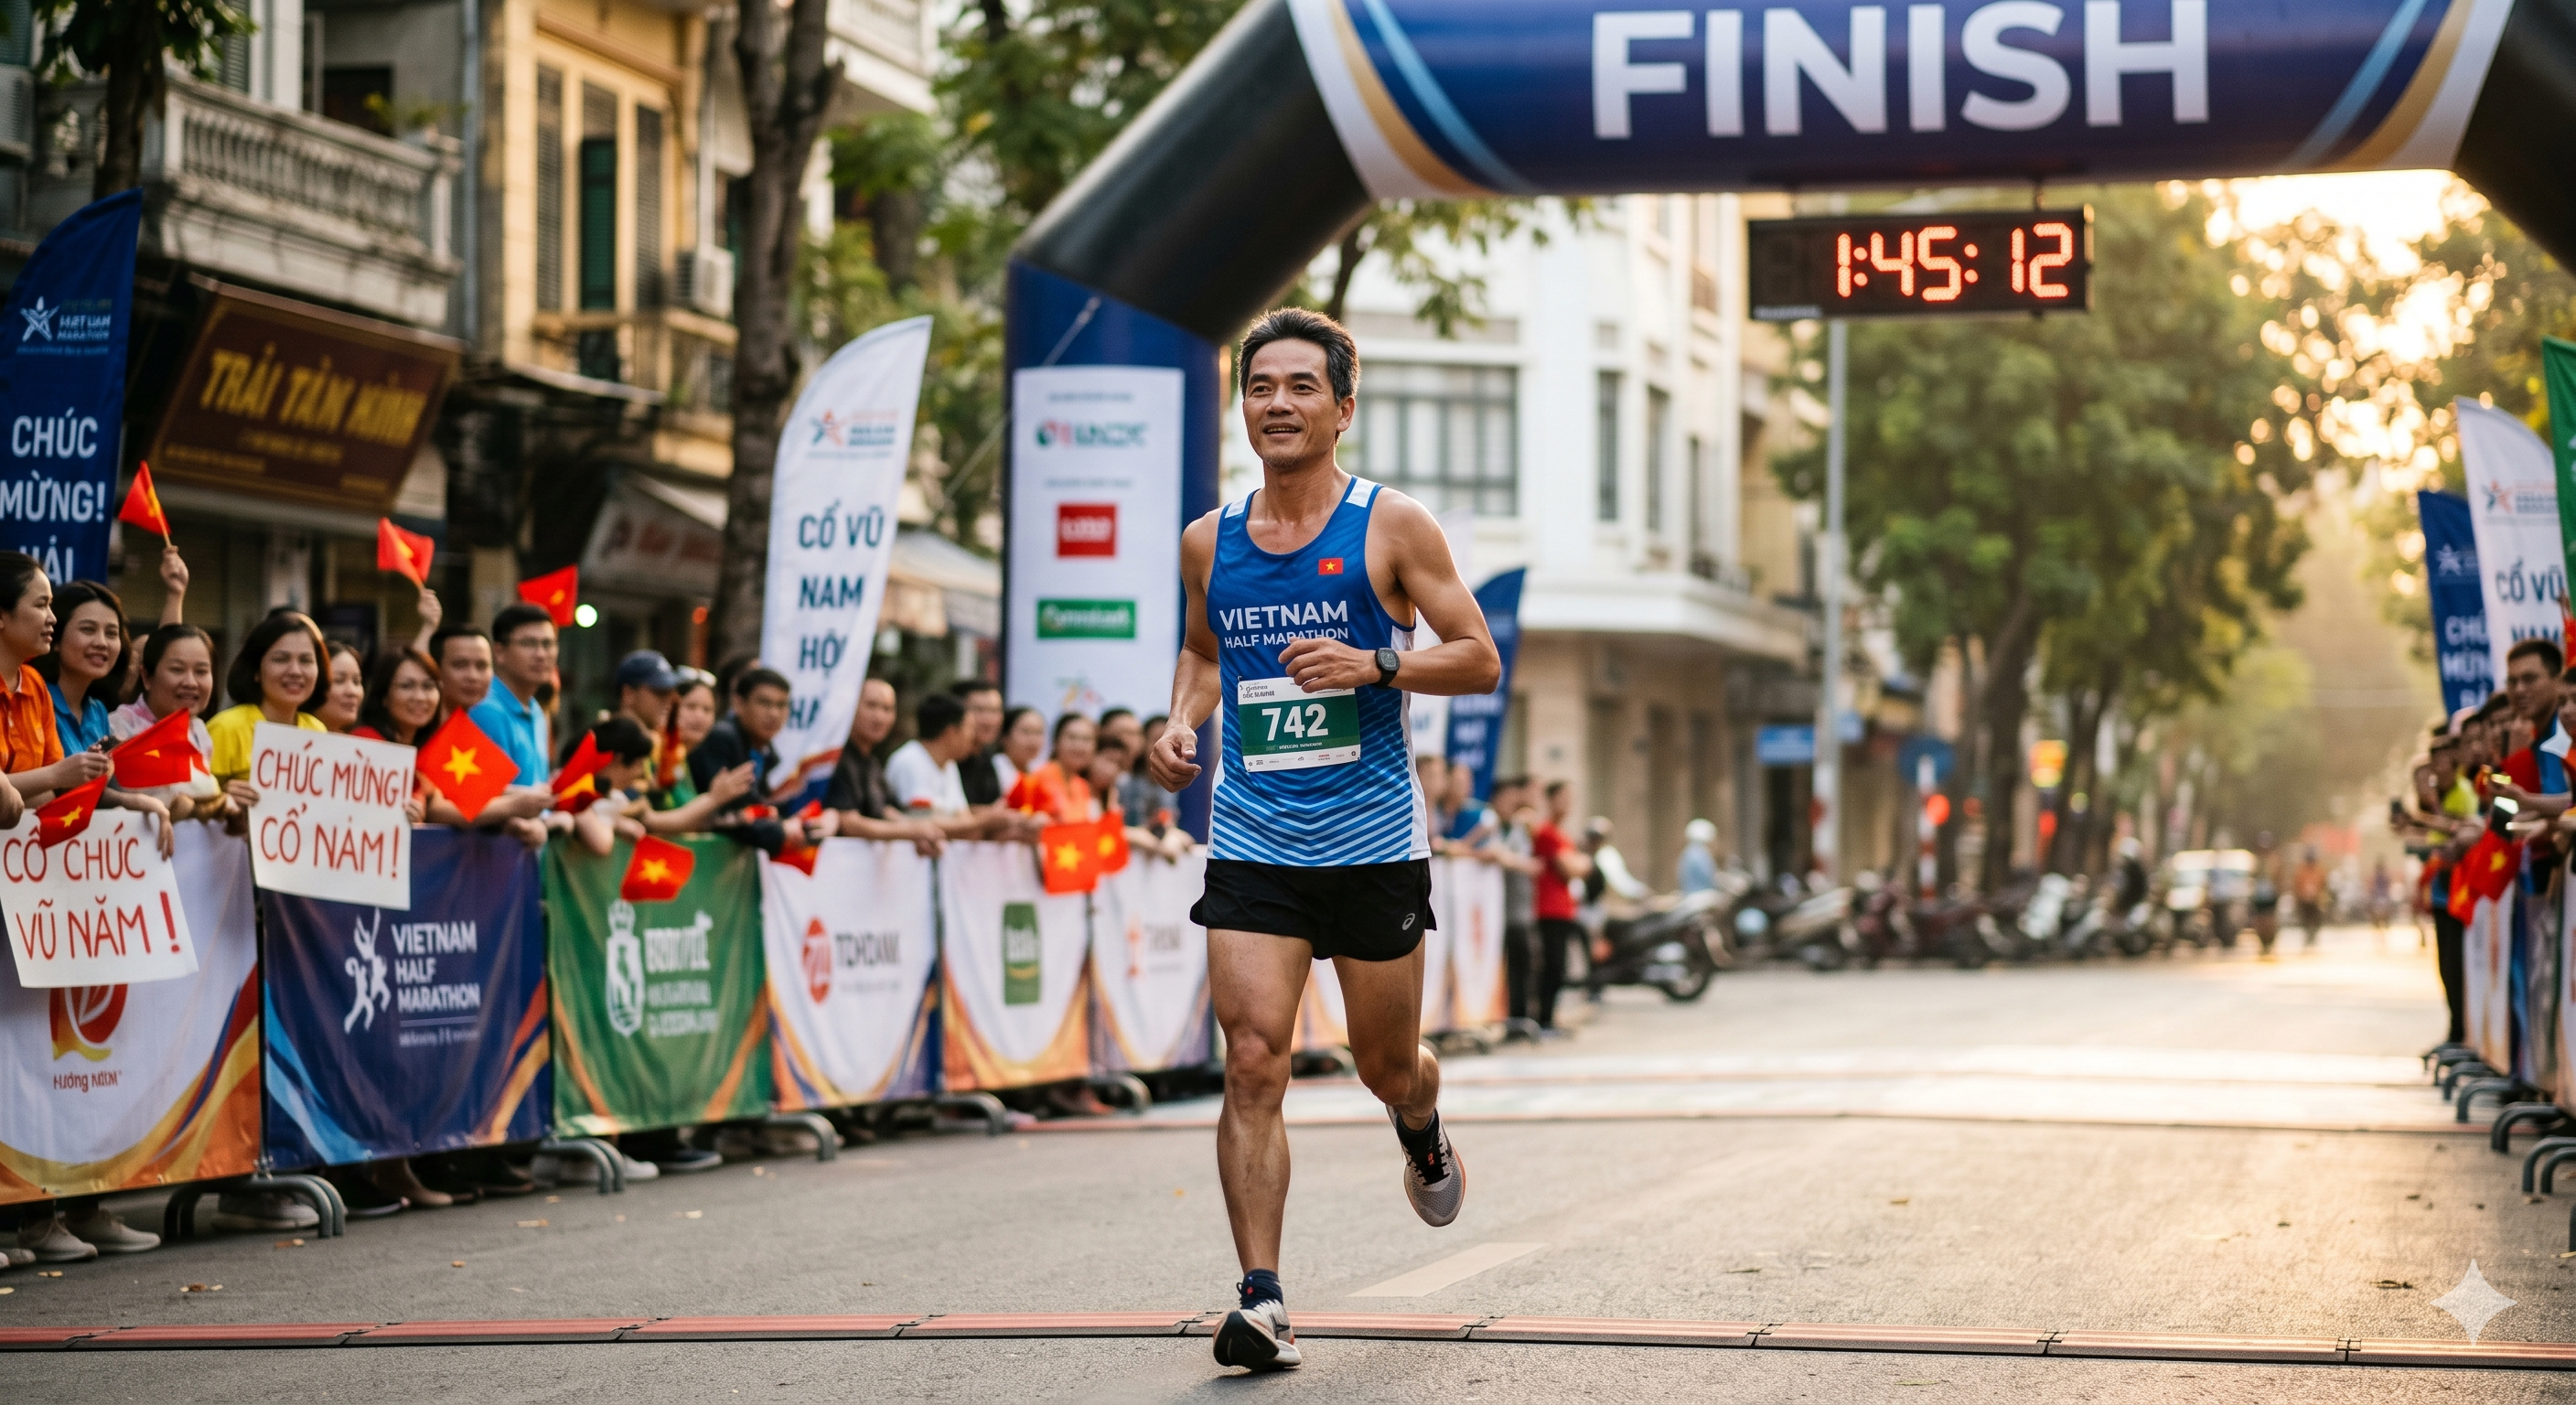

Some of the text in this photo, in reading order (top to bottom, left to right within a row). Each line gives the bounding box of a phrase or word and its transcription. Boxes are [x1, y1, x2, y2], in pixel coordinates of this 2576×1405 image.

[1592, 0, 2208, 139] FINISH
[12, 407, 98, 458] CHÚC
[0, 469, 106, 523] MỪNG!
[799, 575, 864, 610] NAM
[1218, 600, 1348, 631] VIETNAM
[1225, 627, 1348, 649] HALF MARATHON
[1261, 703, 1329, 741] 742
[257, 740, 324, 797] CHÚC
[63, 821, 146, 882] CHÚC
[16, 897, 57, 960] VŨ
[67, 894, 152, 960] NĂM
[391, 920, 478, 955] VIETNAM
[394, 957, 436, 985] HALF
[397, 982, 481, 1013] MARATHON
